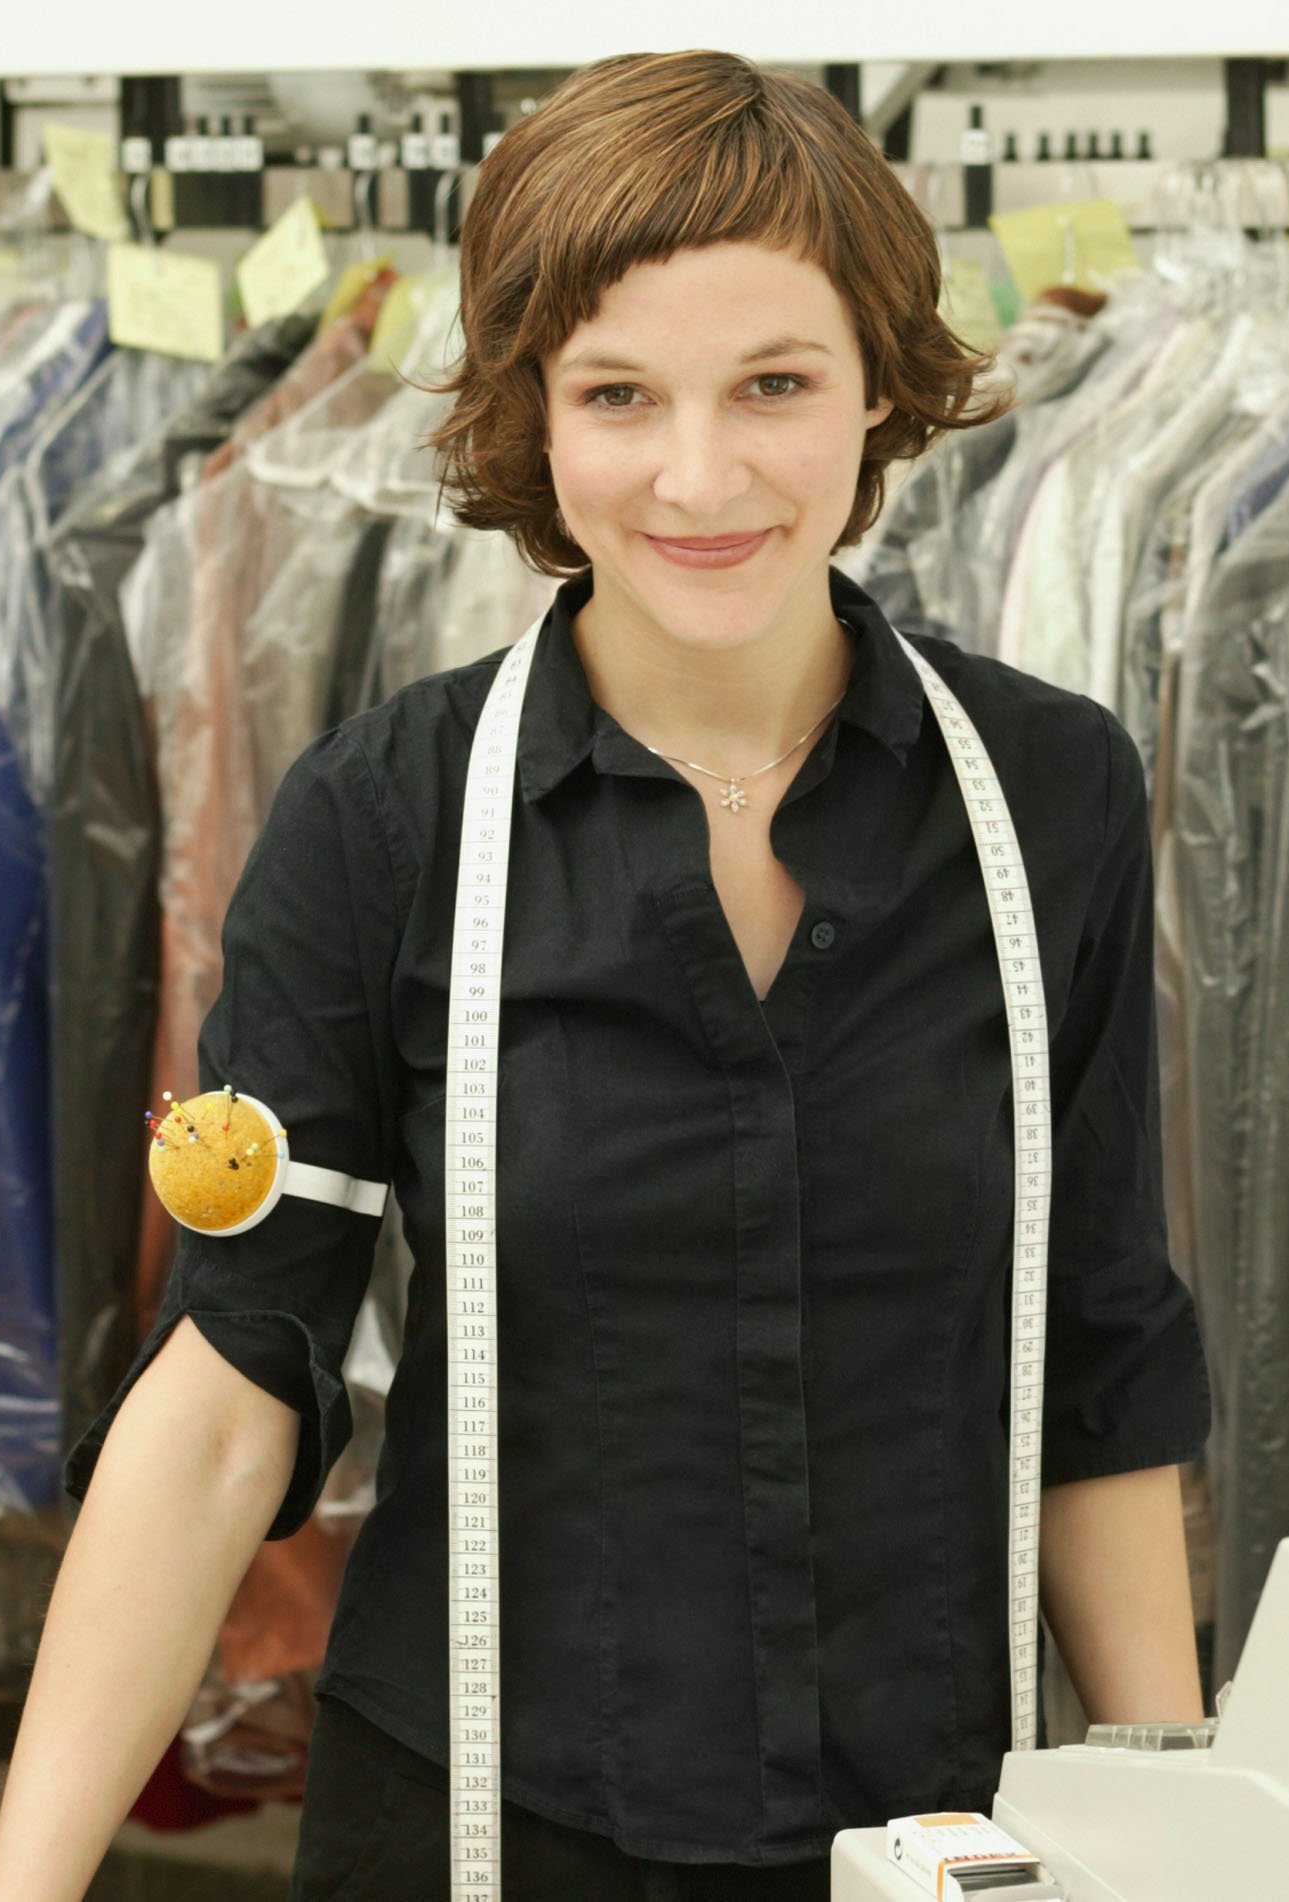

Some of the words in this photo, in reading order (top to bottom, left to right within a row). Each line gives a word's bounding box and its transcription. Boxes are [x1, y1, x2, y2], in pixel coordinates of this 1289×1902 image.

[965, 758, 979, 771] 54
[972, 780, 986, 791] 53
[480, 807, 495, 818] 91
[979, 800, 994, 812] 52
[985, 821, 999, 834] 51
[479, 829, 495, 840] 92
[477, 851, 494, 862] 93
[990, 845, 1005, 857] 50
[476, 872, 491, 883] 94
[996, 867, 1010, 880] 49
[474, 895, 490, 906] 95
[1001, 890, 1015, 902] 48
[472, 917, 489, 929] 96
[1006, 913, 1019, 925] 47
[471, 940, 487, 951] 97
[1009, 936, 1023, 948] 46
[470, 962, 486, 975] 98
[1012, 960, 1025, 973] 45
[468, 986, 485, 998] 99
[1016, 984, 1029, 996] 44
[464, 1010, 488, 1022] 100
[1019, 1007, 1032, 1020] 43
[463, 1034, 486, 1047] 101
[1022, 1031, 1034, 1043] 42
[463, 1058, 487, 1071] 102
[1024, 1055, 1035, 1068] 41
[463, 1083, 486, 1095] 103
[1024, 1079, 1036, 1092] 40
[462, 1107, 485, 1120] 104
[1026, 1103, 1038, 1116] 39
[461, 1131, 484, 1144] 105
[1026, 1128, 1038, 1140] 38
[461, 1156, 484, 1169] 106
[1027, 1151, 1039, 1164] 37
[461, 1180, 484, 1193] 107
[1027, 1175, 1039, 1187] 36
[461, 1205, 485, 1217] 108
[1026, 1199, 1038, 1212] 35
[461, 1229, 484, 1242] 109
[1025, 1223, 1037, 1235] 34
[1025, 1246, 1037, 1258] 33
[461, 1253, 485, 1266] 110
[1023, 1270, 1035, 1282] 32
[462, 1277, 484, 1290] 111
[1024, 1294, 1034, 1306] 31
[462, 1301, 485, 1314] 112
[1022, 1317, 1034, 1329] 30
[463, 1325, 485, 1337] 113
[463, 1348, 485, 1361] 114
[463, 1372, 485, 1385] 115
[463, 1396, 486, 1409] 116
[463, 1420, 486, 1433] 117
[463, 1444, 486, 1457] 118
[463, 1468, 486, 1481] 119
[463, 1492, 487, 1505] 120
[463, 1516, 486, 1528] 121
[463, 1539, 487, 1552] 122
[464, 1563, 487, 1576] 123
[464, 1587, 487, 1599] 124
[464, 1610, 487, 1623] 125
[464, 1634, 487, 1647] 126
[464, 1658, 487, 1671] 127
[463, 1682, 488, 1694] 128
[464, 1705, 487, 1717] 129
[464, 1729, 487, 1741] 130
[465, 1752, 487, 1765] 131
[465, 1776, 488, 1789] 132
[465, 1800, 488, 1812] 133
[465, 1823, 488, 1836] 134
[465, 1847, 488, 1860] 135
[465, 1871, 489, 1883] 136
